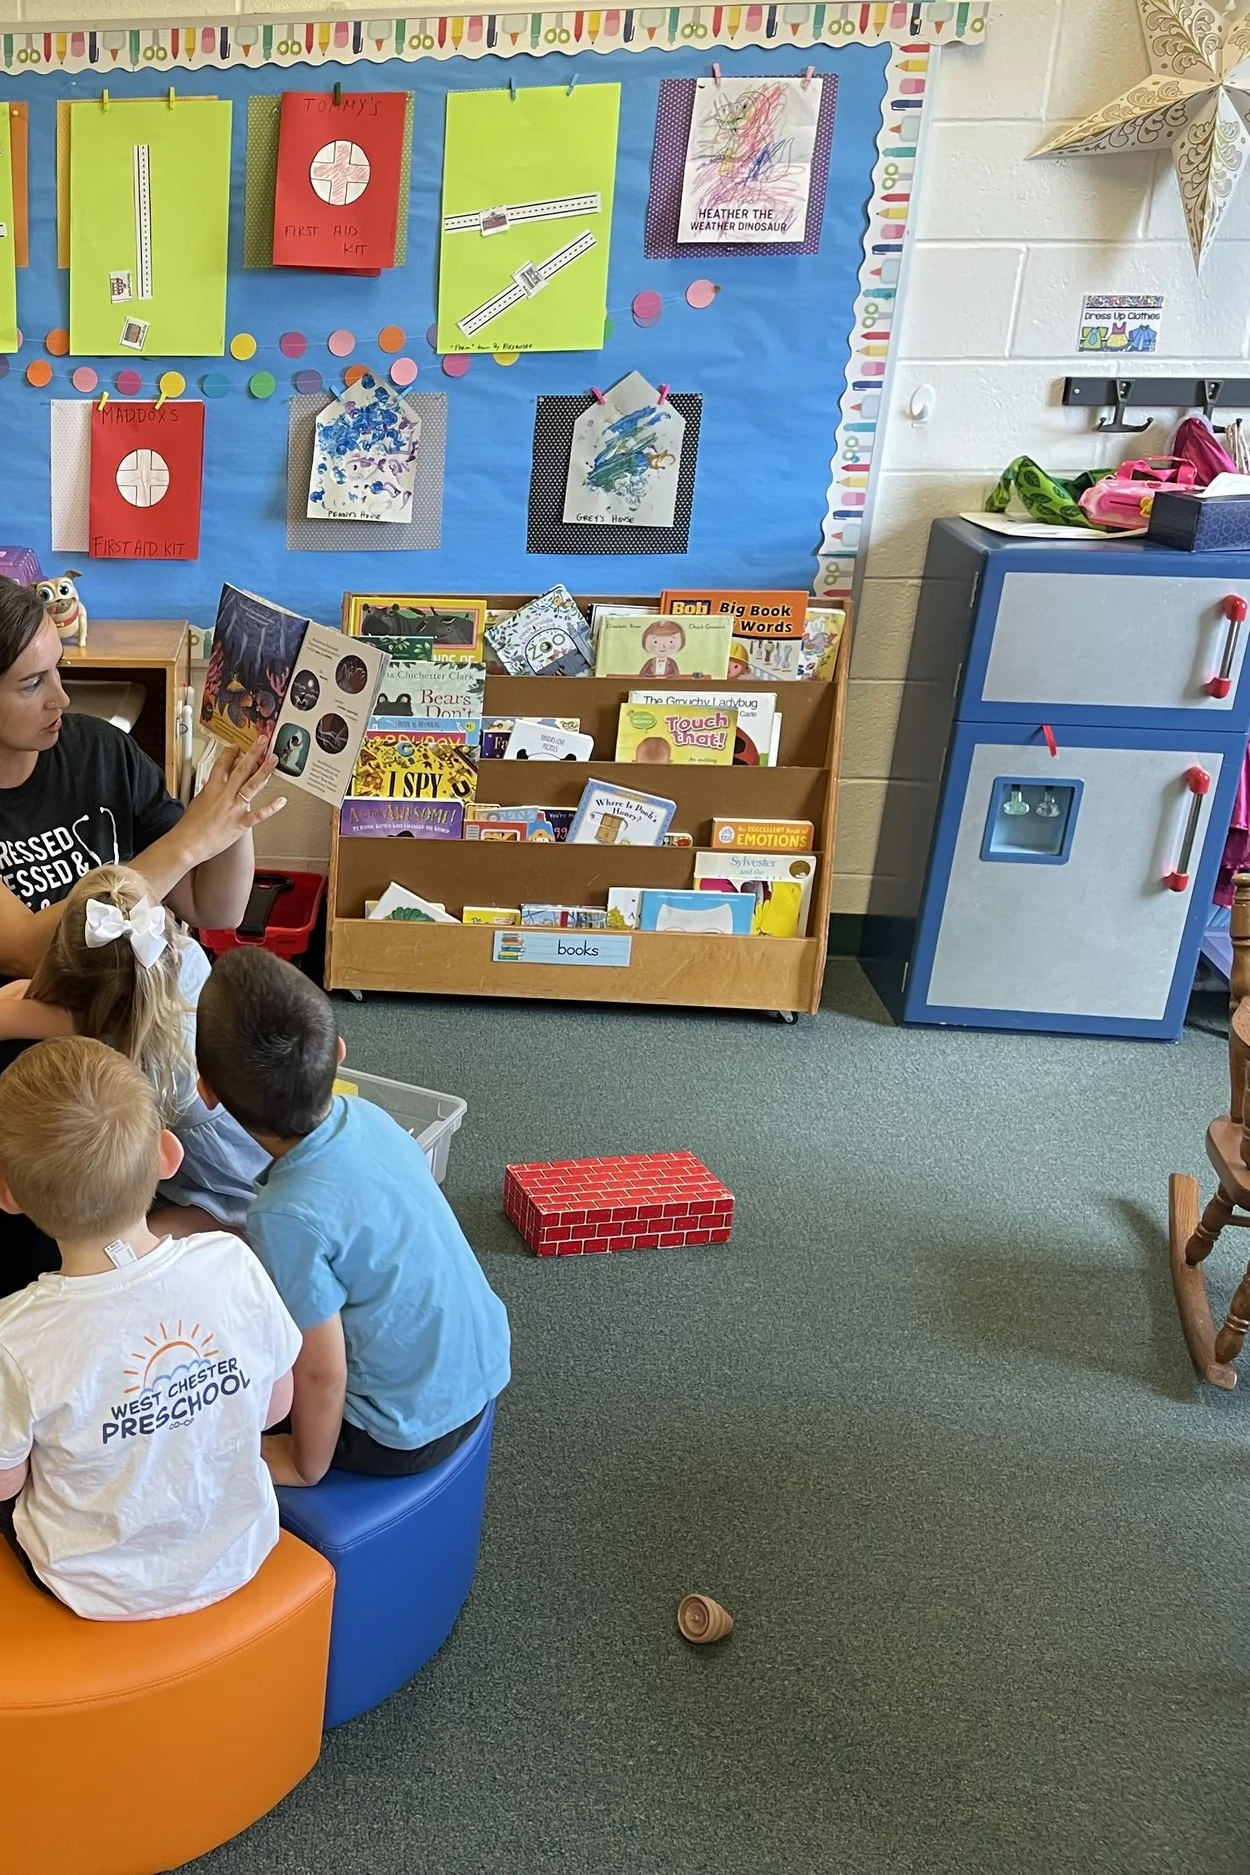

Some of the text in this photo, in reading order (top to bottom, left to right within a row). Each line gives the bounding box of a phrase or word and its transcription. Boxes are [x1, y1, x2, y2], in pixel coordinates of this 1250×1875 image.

[304, 96, 382, 117] TOMMY'S
[698, 209, 774, 220] HEATHER THE
[284, 225, 358, 237] FIRST AID
[690, 221, 788, 232] WEATHER DINOSAUR
[344, 243, 368, 255] KIT
[1085, 312, 1160, 321] Dress Up Clothes
[102, 407, 179, 424] MADDOX'S
[92, 536, 186, 557] FIRST AID KIT
[672, 601, 791, 617] Bob Big Book
[741, 620, 792, 633] Words
[397, 671, 445, 680] Chichester
[448, 671, 474, 680] Clark
[421, 689, 472, 706] Bears
[643, 696, 758, 710] The Grouchy Ladybug
[425, 706, 475, 718] Don't
[664, 712, 730, 732] Touch
[671, 730, 728, 751] that!
[388, 771, 444, 798] I SPY
[595, 798, 657, 823] Where Is Pooh's
[611, 806, 643, 822] Honey?
[736, 833, 809, 848] EMOTIONS
[71, 851, 90, 878] &
[731, 855, 776, 868] Sylvester
[557, 939, 599, 957] books
[111, 1357, 238, 1420] WEST CHESTER
[102, 1369, 251, 1445] PRESCHOOL
